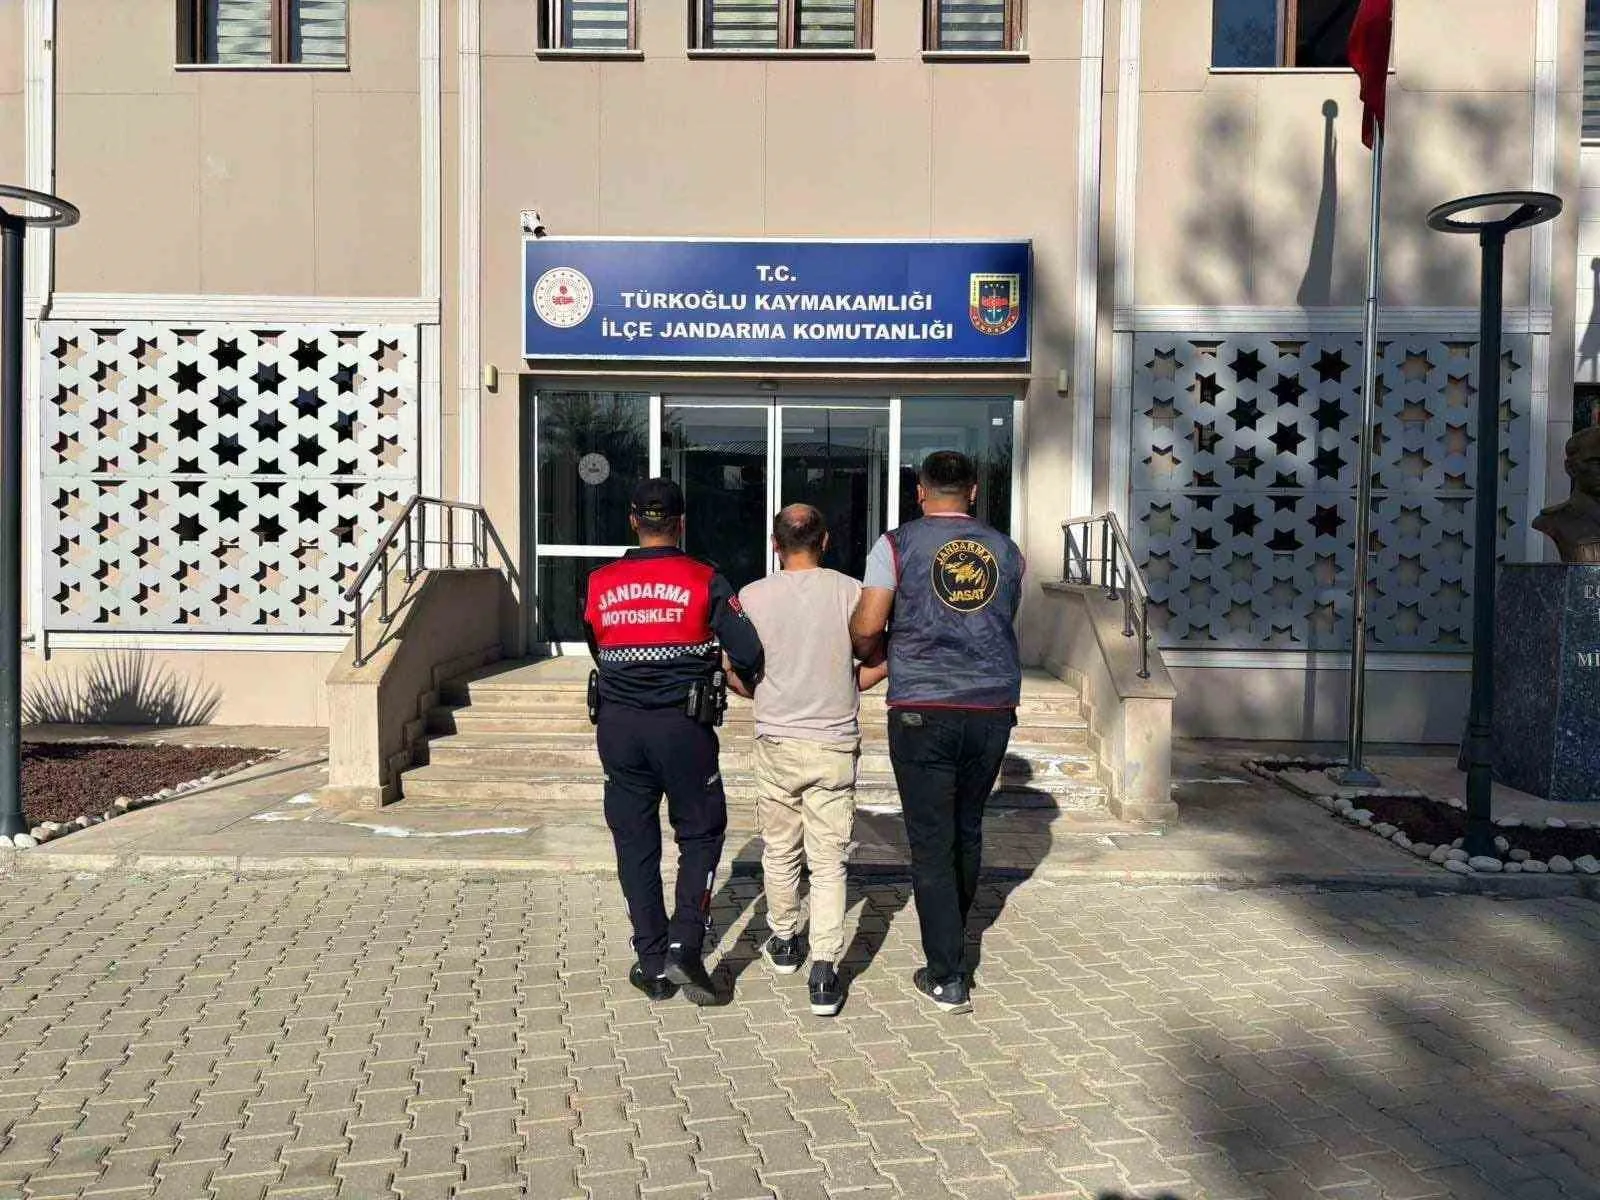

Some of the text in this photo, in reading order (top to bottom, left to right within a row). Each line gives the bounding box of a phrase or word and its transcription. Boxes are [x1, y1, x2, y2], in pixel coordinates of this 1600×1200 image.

[756, 265, 797, 282] T.C.
[621, 290, 932, 311] TÜRKOĞLU KAYMAKAMLIĞI
[602, 317, 653, 341] İLÇE
[660, 322, 786, 339] JANDARMA
[793, 320, 953, 340] KOMUTANLIĞI
[937, 542, 991, 565] JANDARMA
[598, 583, 691, 610] JANDARMA
